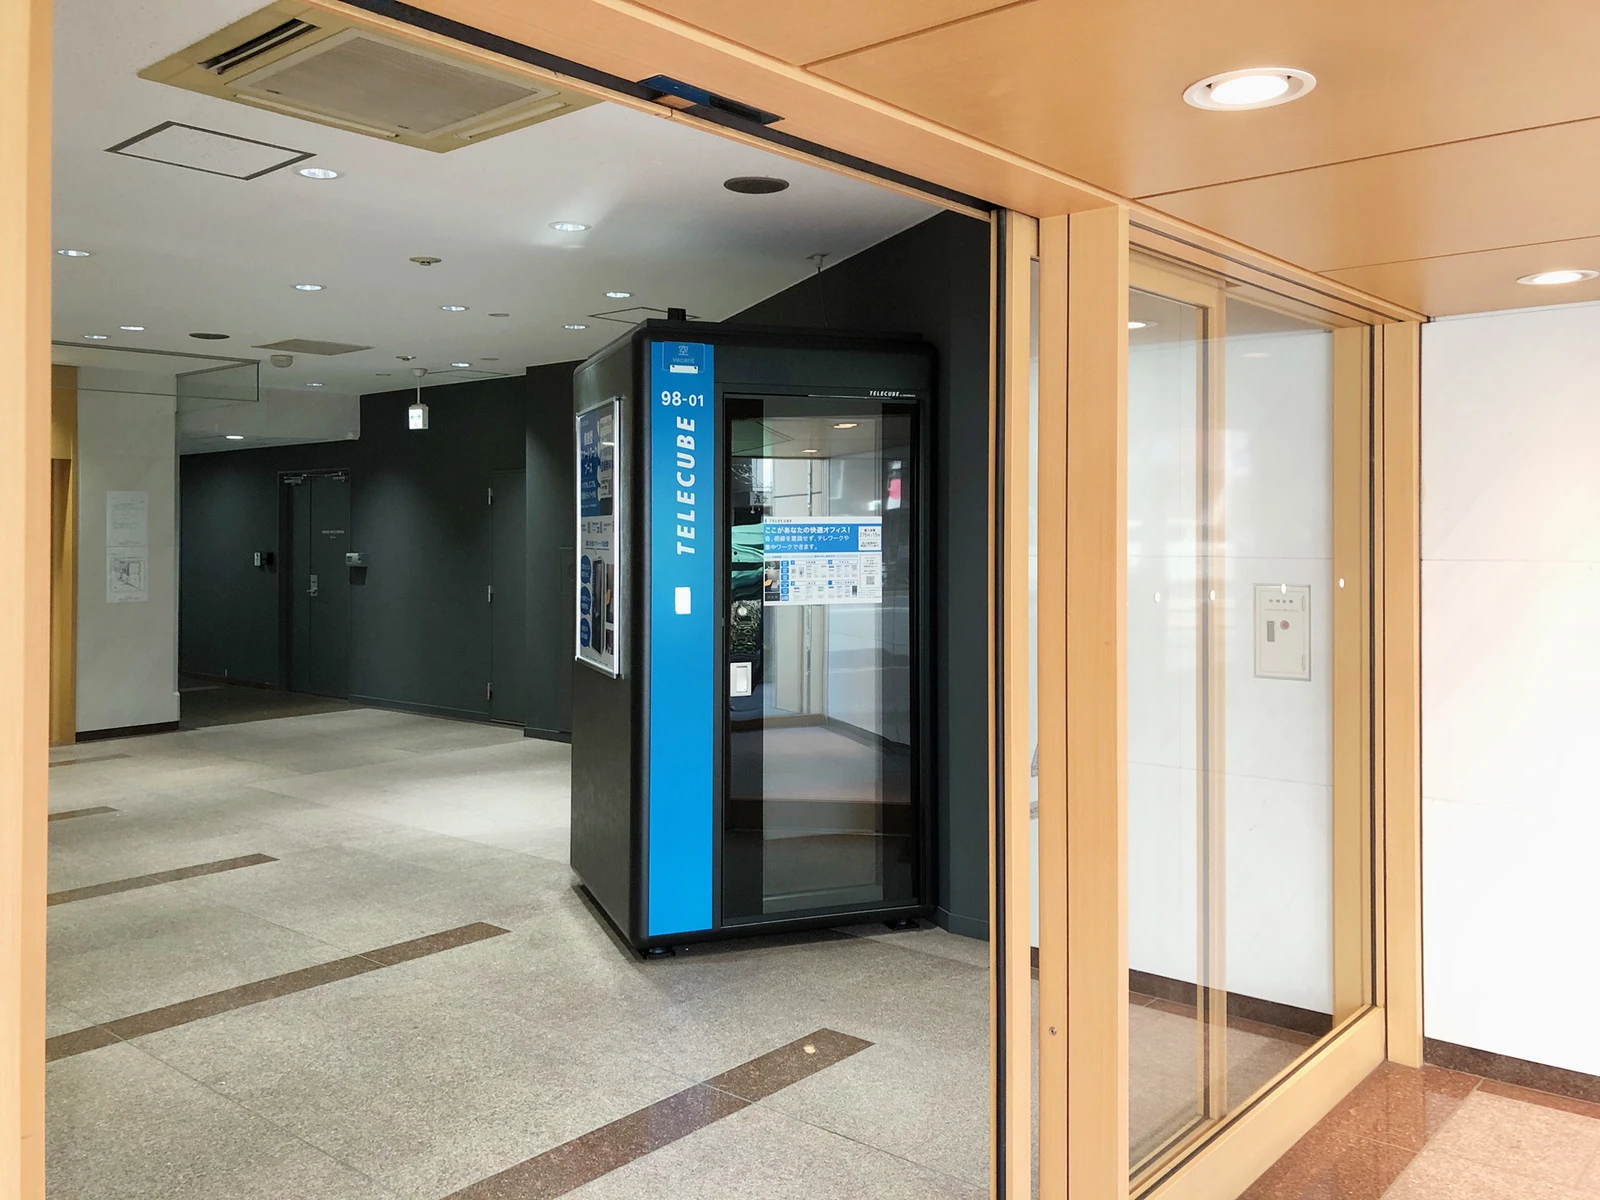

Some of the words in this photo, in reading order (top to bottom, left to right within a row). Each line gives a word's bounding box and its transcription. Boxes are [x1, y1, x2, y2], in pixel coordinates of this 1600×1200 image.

[678, 345, 689, 356] 空
[672, 357, 695, 365] vacant
[661, 390, 704, 407] 98-01
[676, 416, 696, 555] TELECUBE
